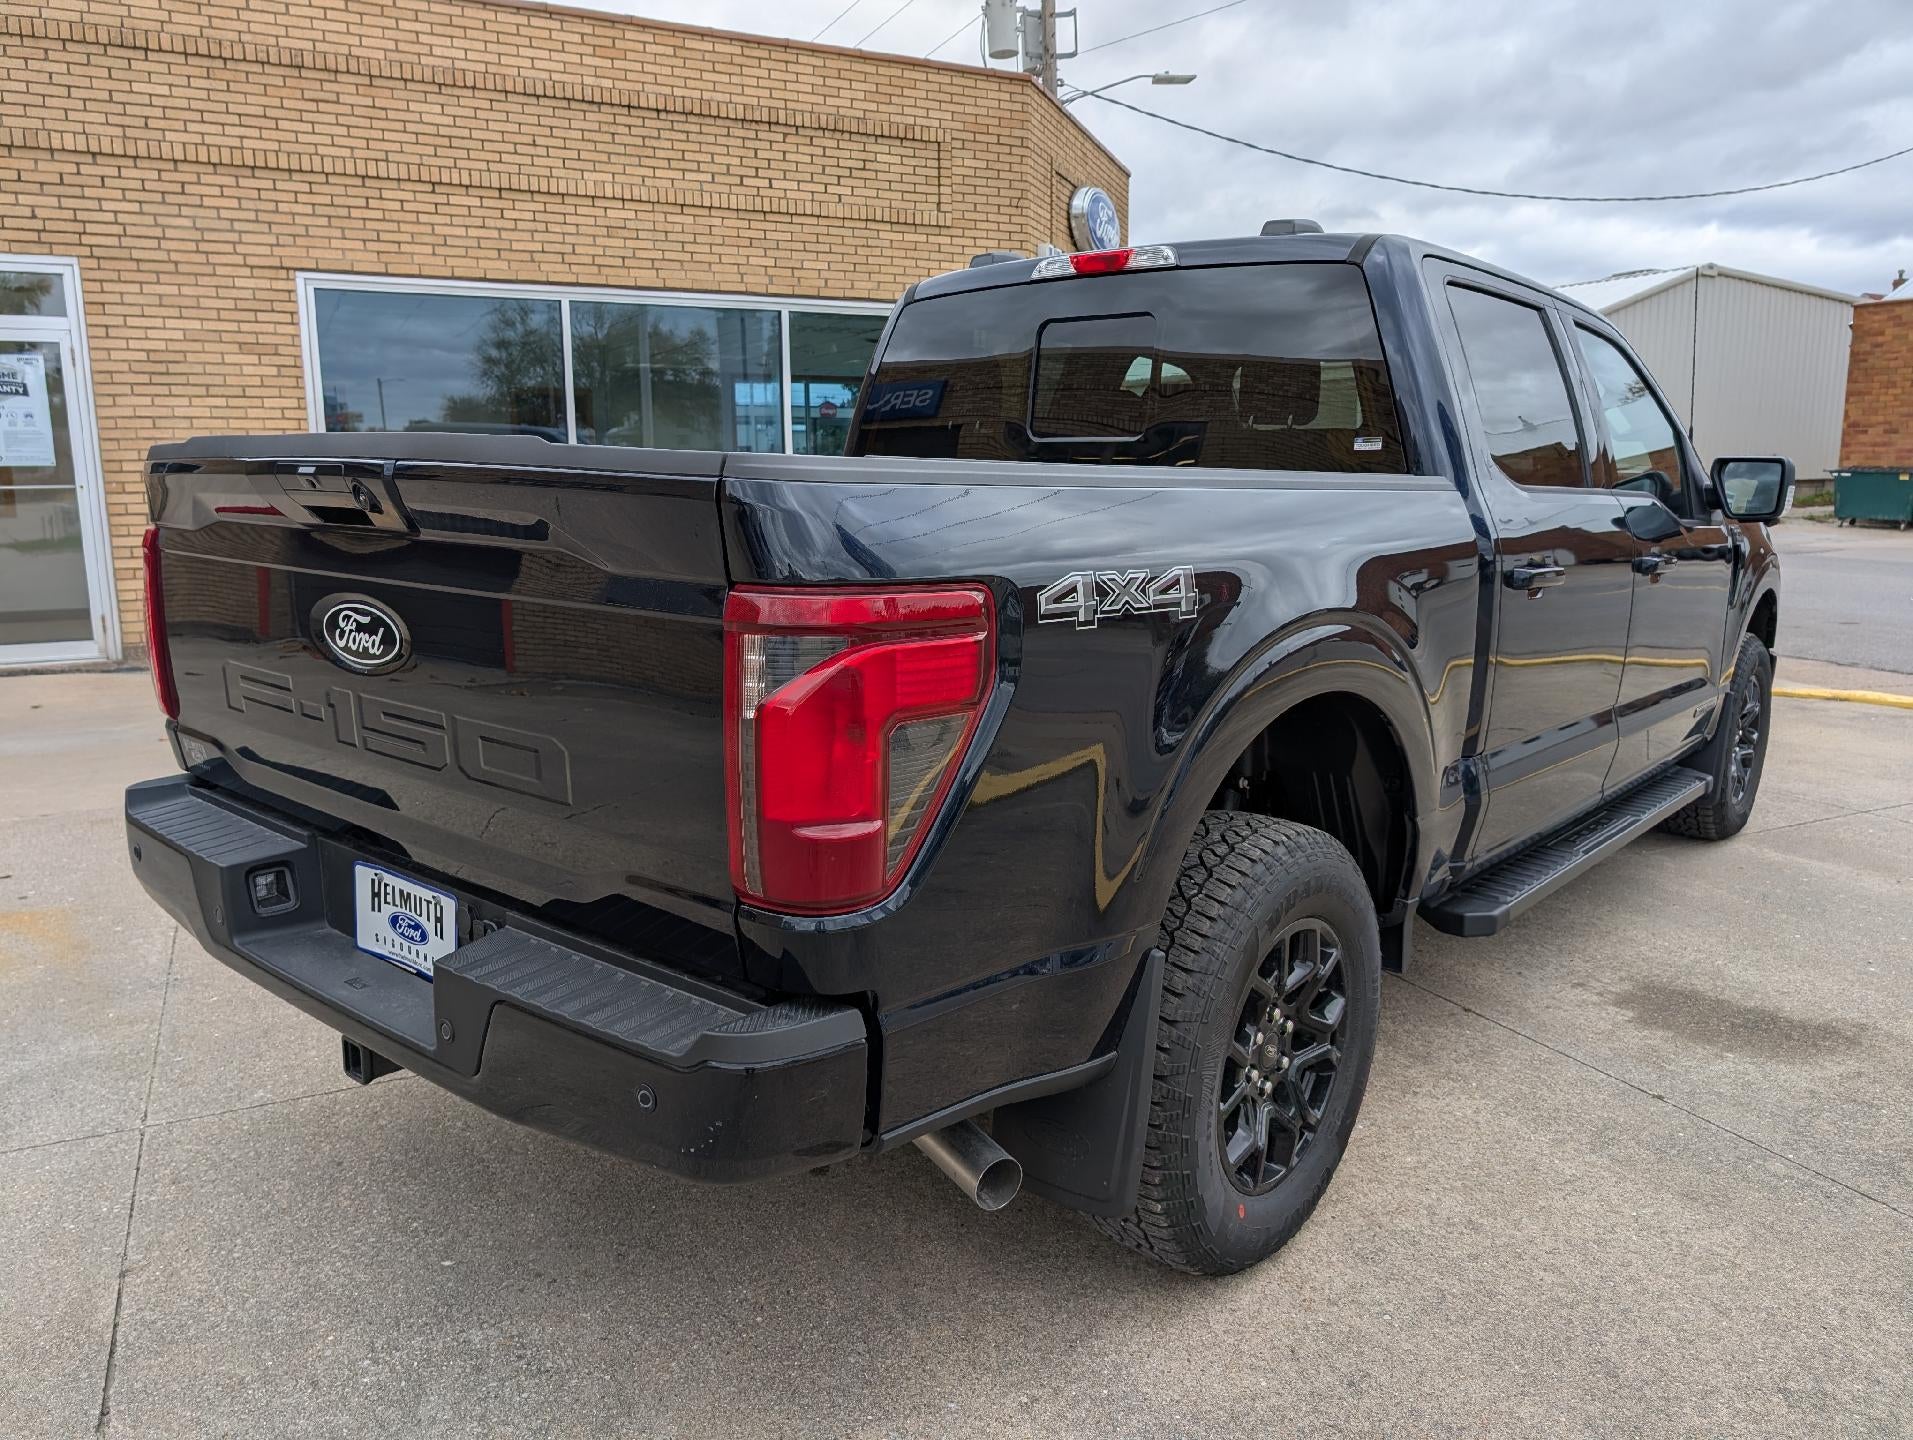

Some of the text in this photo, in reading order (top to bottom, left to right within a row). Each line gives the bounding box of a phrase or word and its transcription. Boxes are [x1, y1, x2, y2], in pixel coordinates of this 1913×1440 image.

[335, 610, 385, 656] Ford
[222, 658, 574, 807] F-150
[370, 876, 445, 941] HELMUTH
[396, 914, 423, 943] Ford
